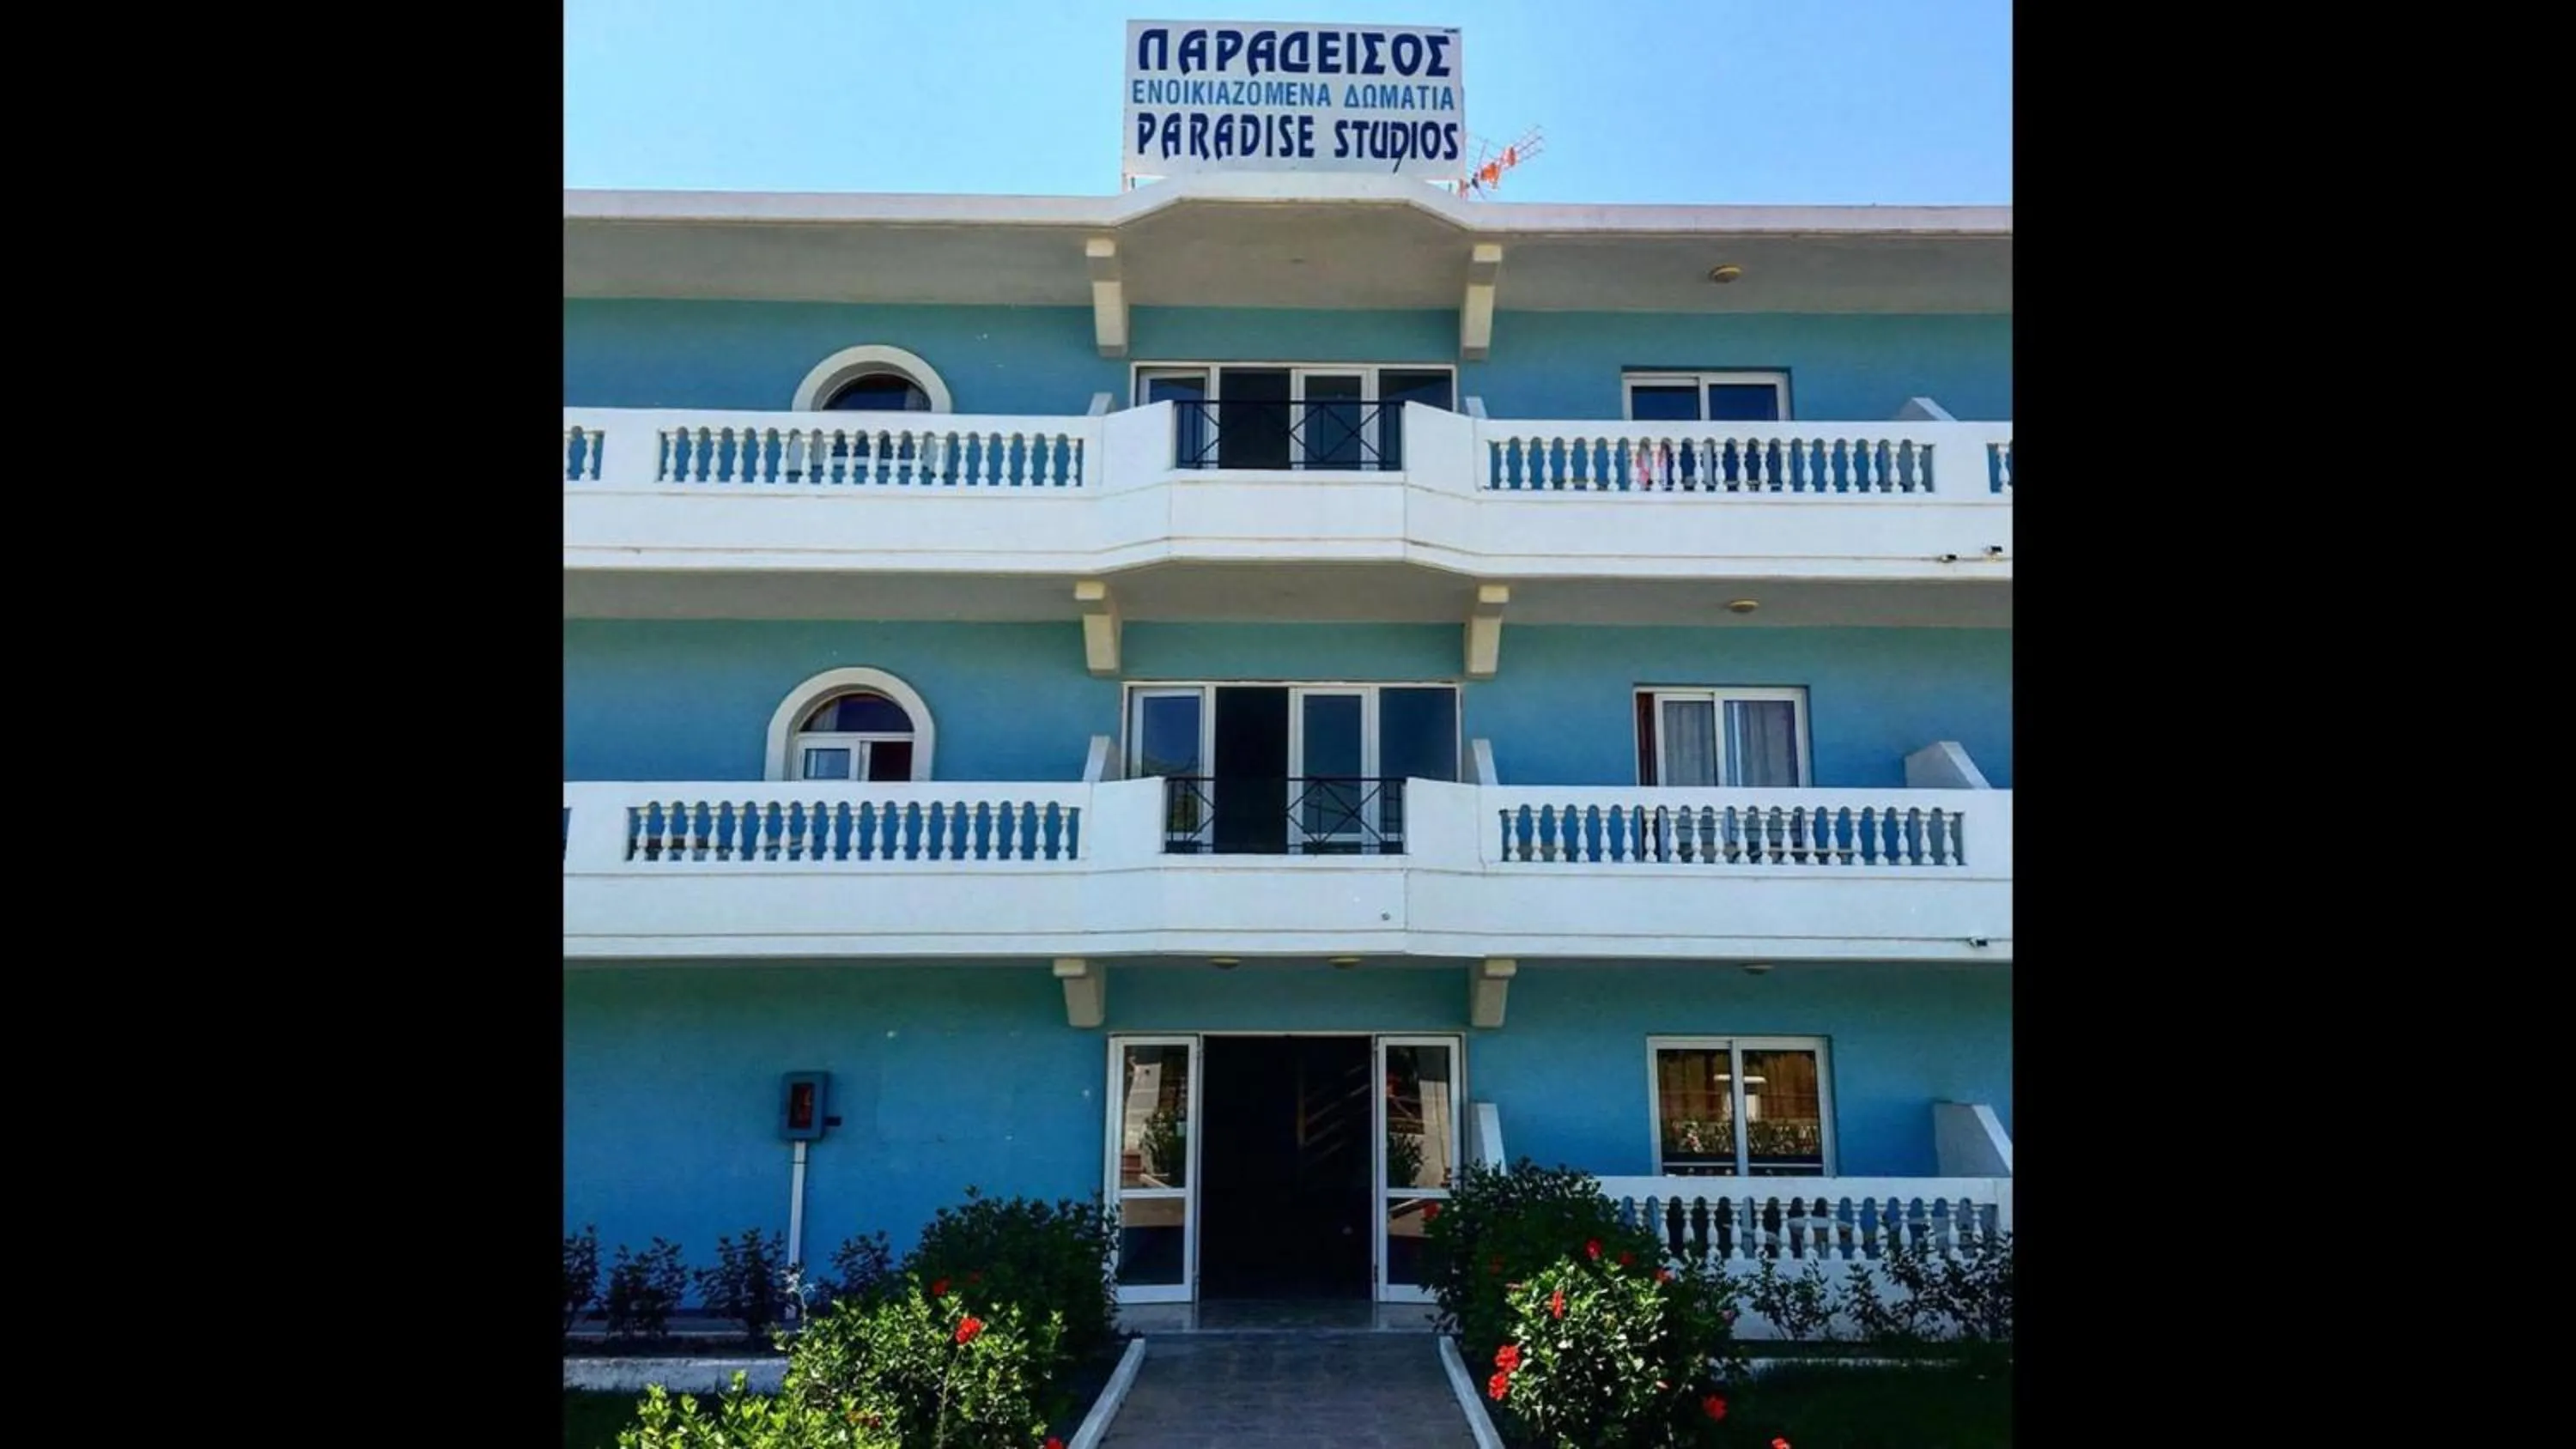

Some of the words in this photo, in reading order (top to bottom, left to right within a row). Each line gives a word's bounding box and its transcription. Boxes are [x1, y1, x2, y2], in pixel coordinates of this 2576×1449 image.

[1138, 28, 1450, 77] ΠΑΡΑΔΕΙΣΟΣ
[1132, 79, 1332, 107] ΕΝΟΙΚΙΑΖΟΜΕΝΑ
[1344, 84, 1455, 111] ΔΩΜΑΤΙΑ
[1137, 112, 1315, 161] PARADISE
[1334, 119, 1458, 173] STUDIOS
